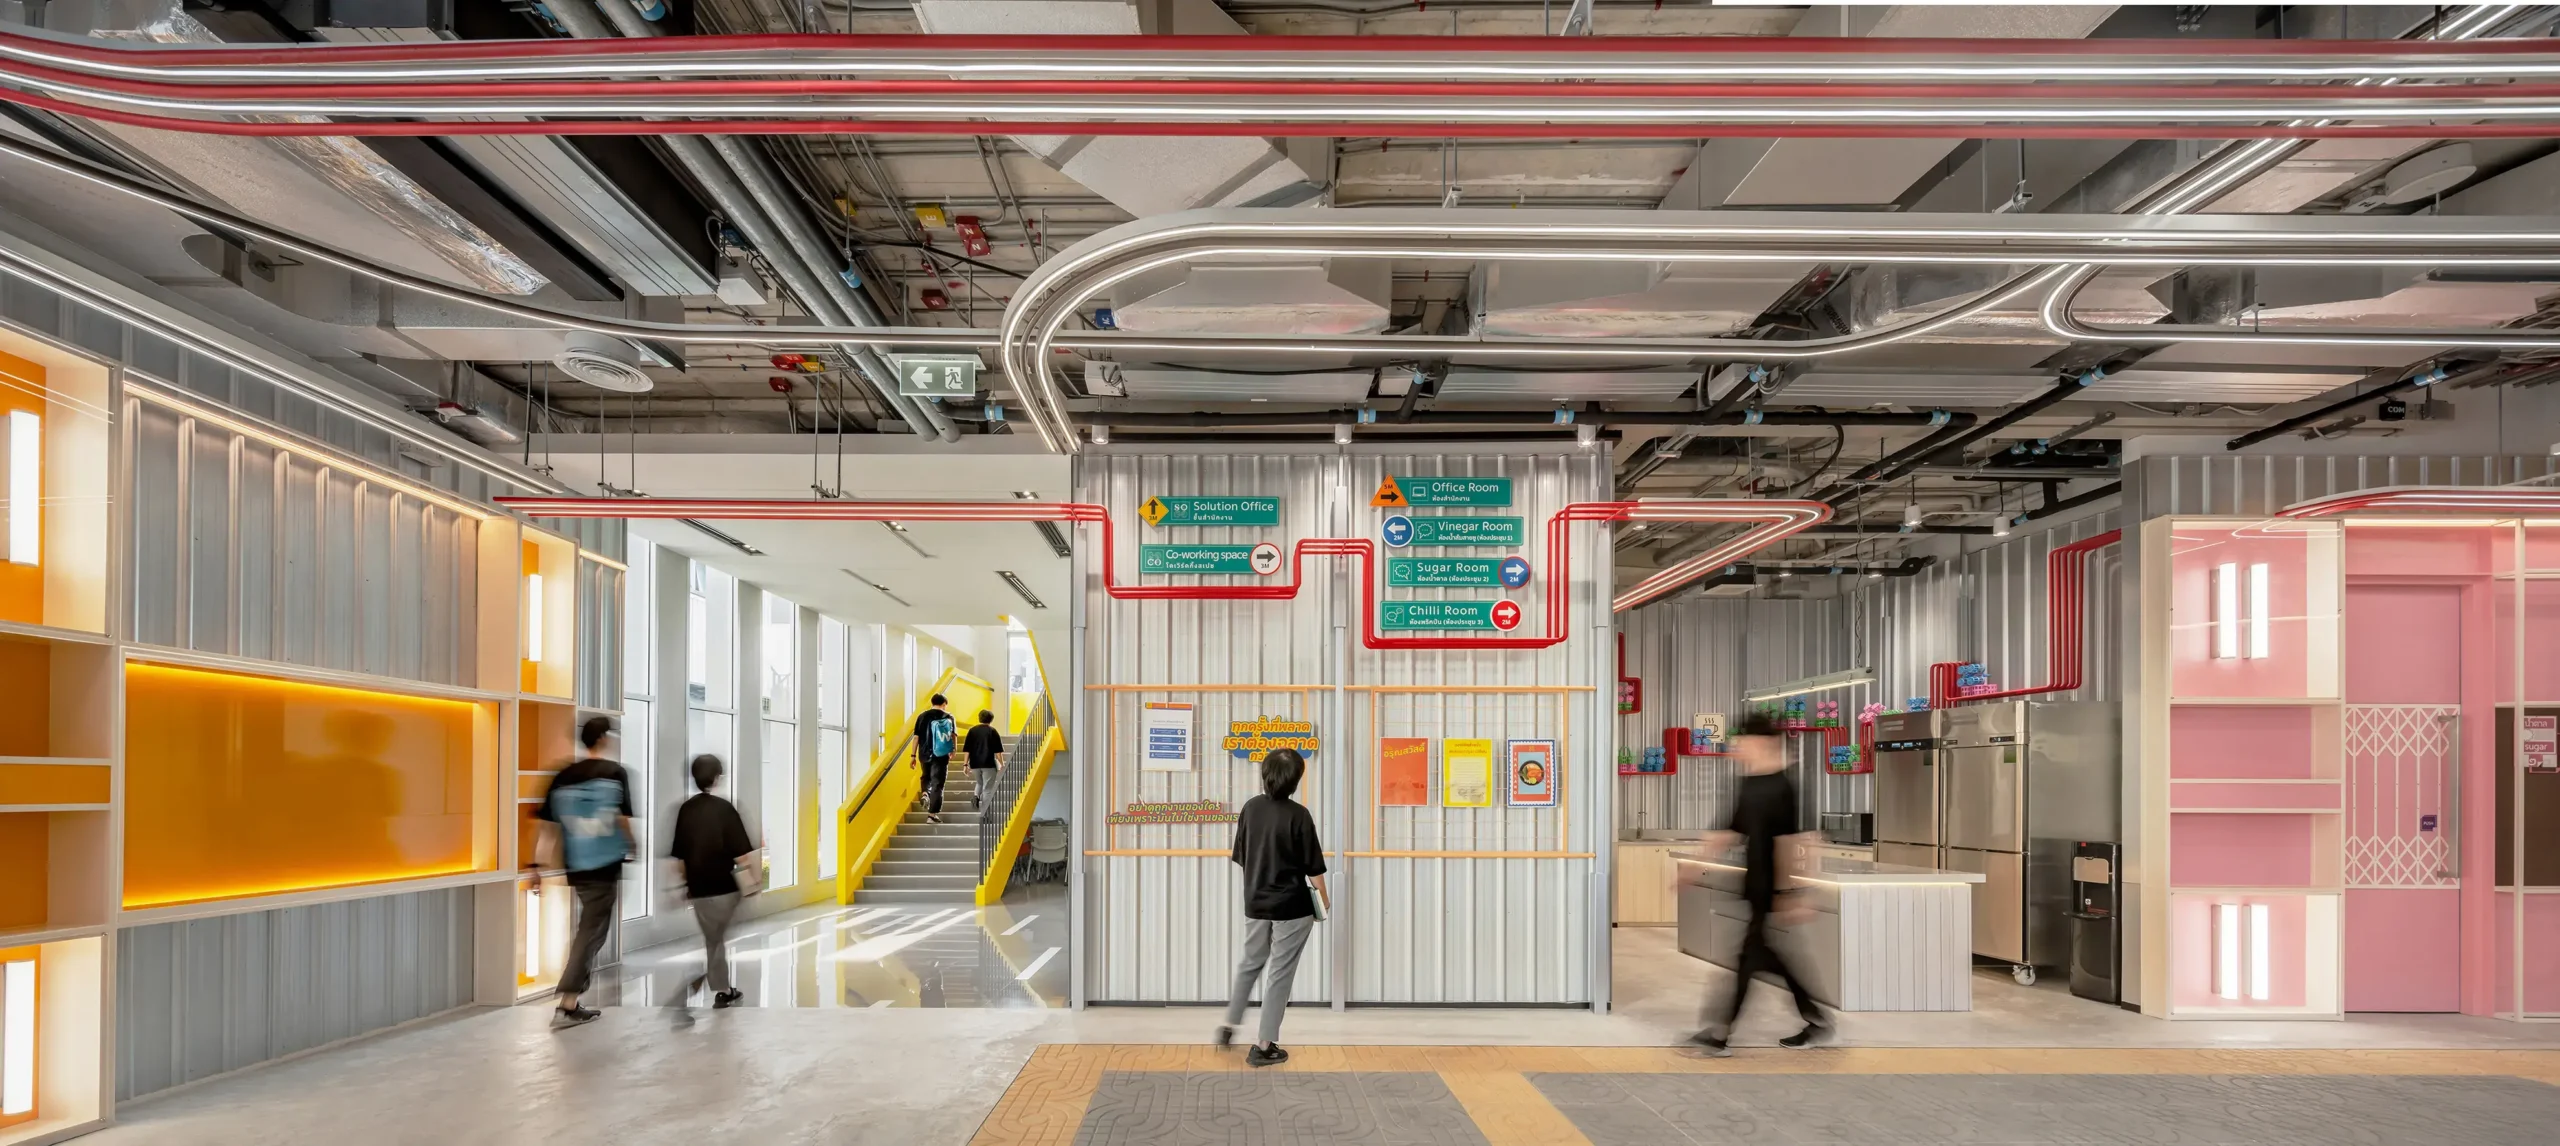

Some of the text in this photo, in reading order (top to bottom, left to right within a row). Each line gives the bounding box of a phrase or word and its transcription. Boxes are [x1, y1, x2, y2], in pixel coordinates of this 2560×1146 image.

[1432, 482, 1499, 492] Office Room
[1193, 501, 1274, 511] Solution Office
[1438, 521, 1513, 533] Vinegar Room
[1165, 549, 1248, 562] Co-working space
[1417, 562, 1489, 574] Sugar Room
[1409, 605, 1478, 616] Chilli Room
[1231, 715, 1311, 735] ทุกครั้งที่พลาด
[2524, 744, 2548, 753] sugar
[1106, 812, 1239, 823] เพียงเพราะมันไม่ใช่งานของเร
